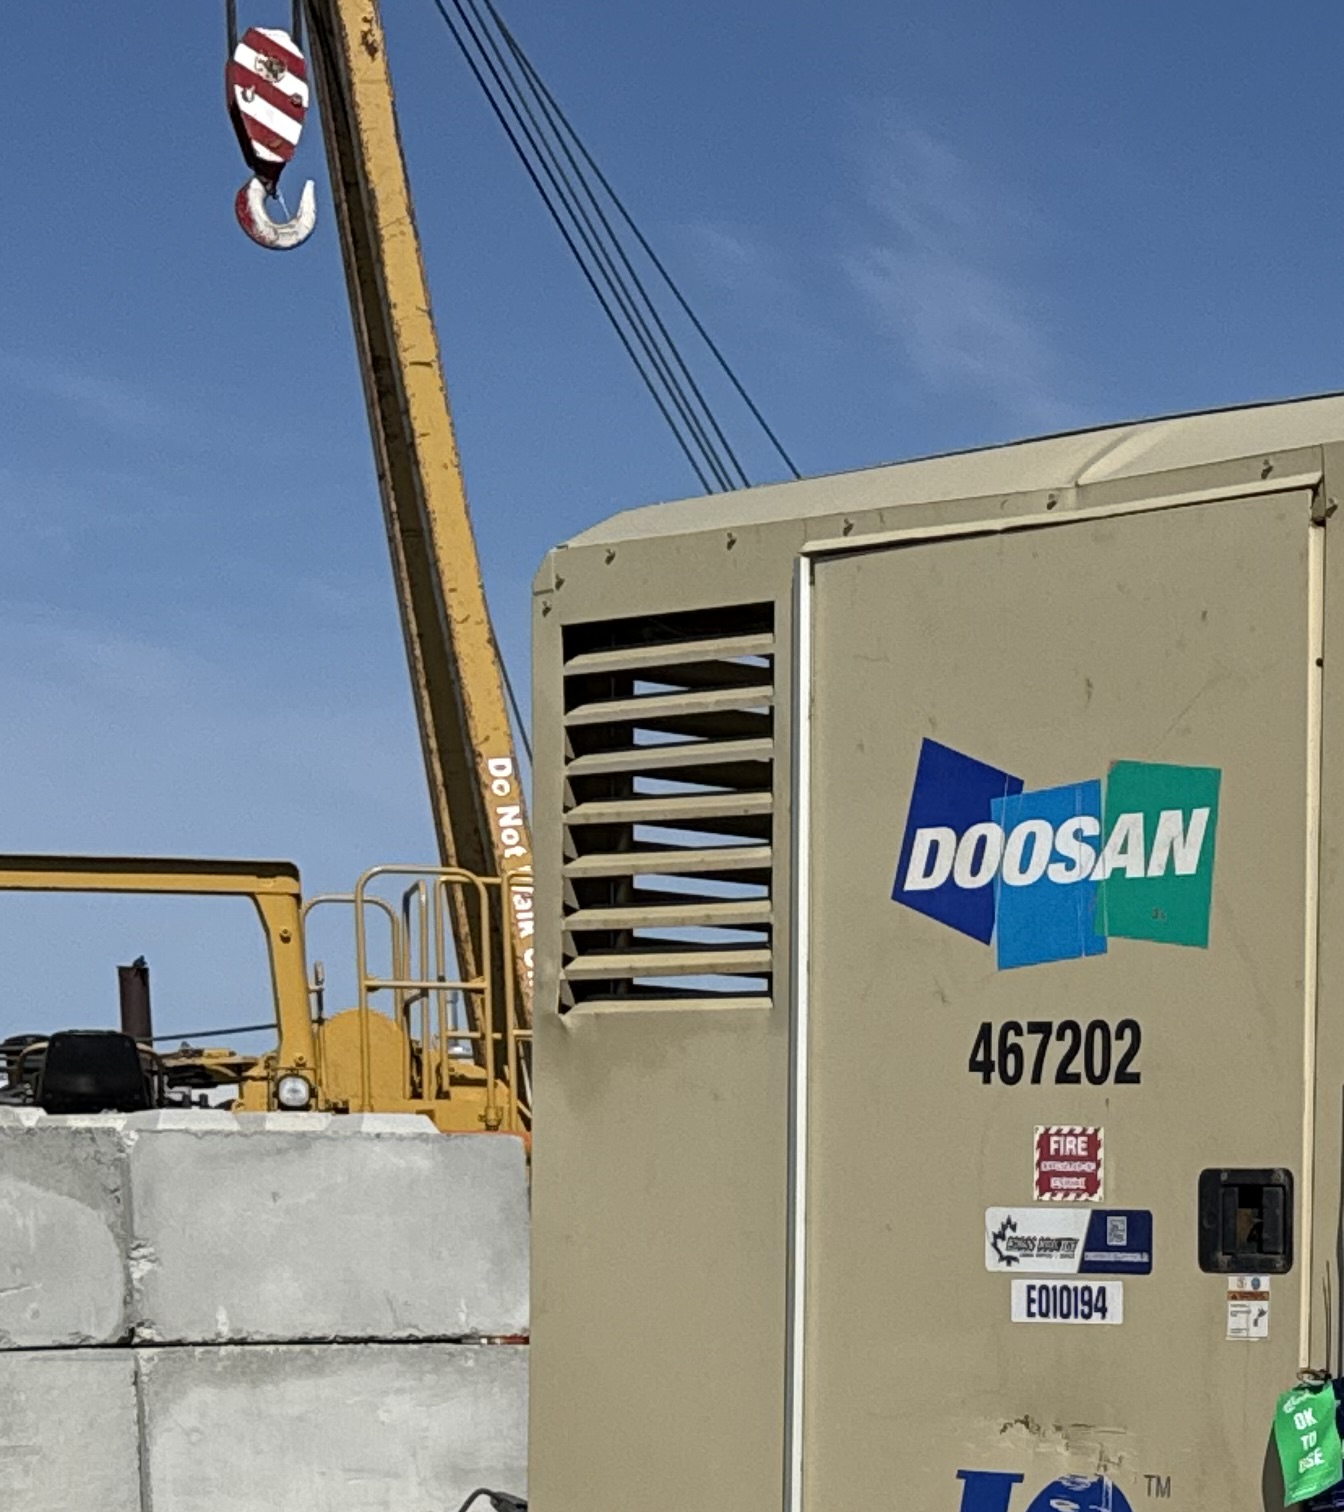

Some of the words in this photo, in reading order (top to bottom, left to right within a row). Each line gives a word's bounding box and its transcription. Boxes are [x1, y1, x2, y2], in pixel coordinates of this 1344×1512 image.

[487, 757, 513, 797] Do
[496, 805, 527, 859] Not
[903, 807, 1210, 892] DOOSAN
[968, 1018, 1142, 1086] 467202
[1049, 1136, 1089, 1156] FIRE
[1293, 1407, 1318, 1430] OK
[1301, 1430, 1318, 1451] TO
